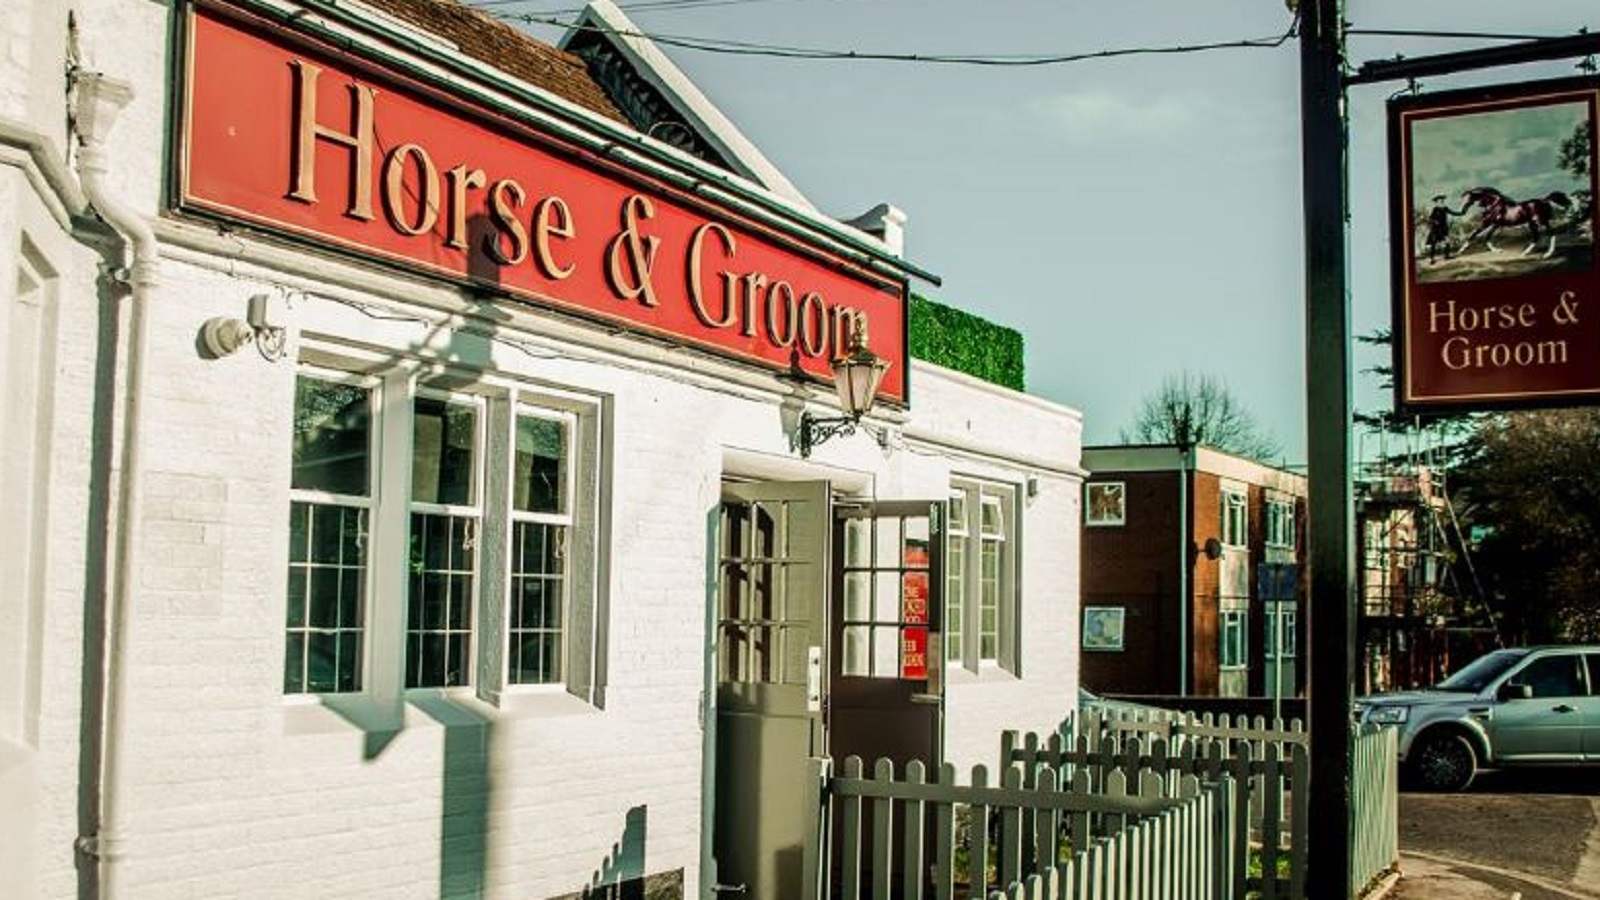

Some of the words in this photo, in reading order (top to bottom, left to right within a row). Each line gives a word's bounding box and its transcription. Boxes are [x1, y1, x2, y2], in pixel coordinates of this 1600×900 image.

[287, 60, 576, 280] Horse
[609, 195, 662, 306] &
[688, 222, 868, 360] Groom
[1429, 301, 1536, 333] Horse
[1553, 290, 1579, 324] &
[1442, 337, 1567, 370] Groom
